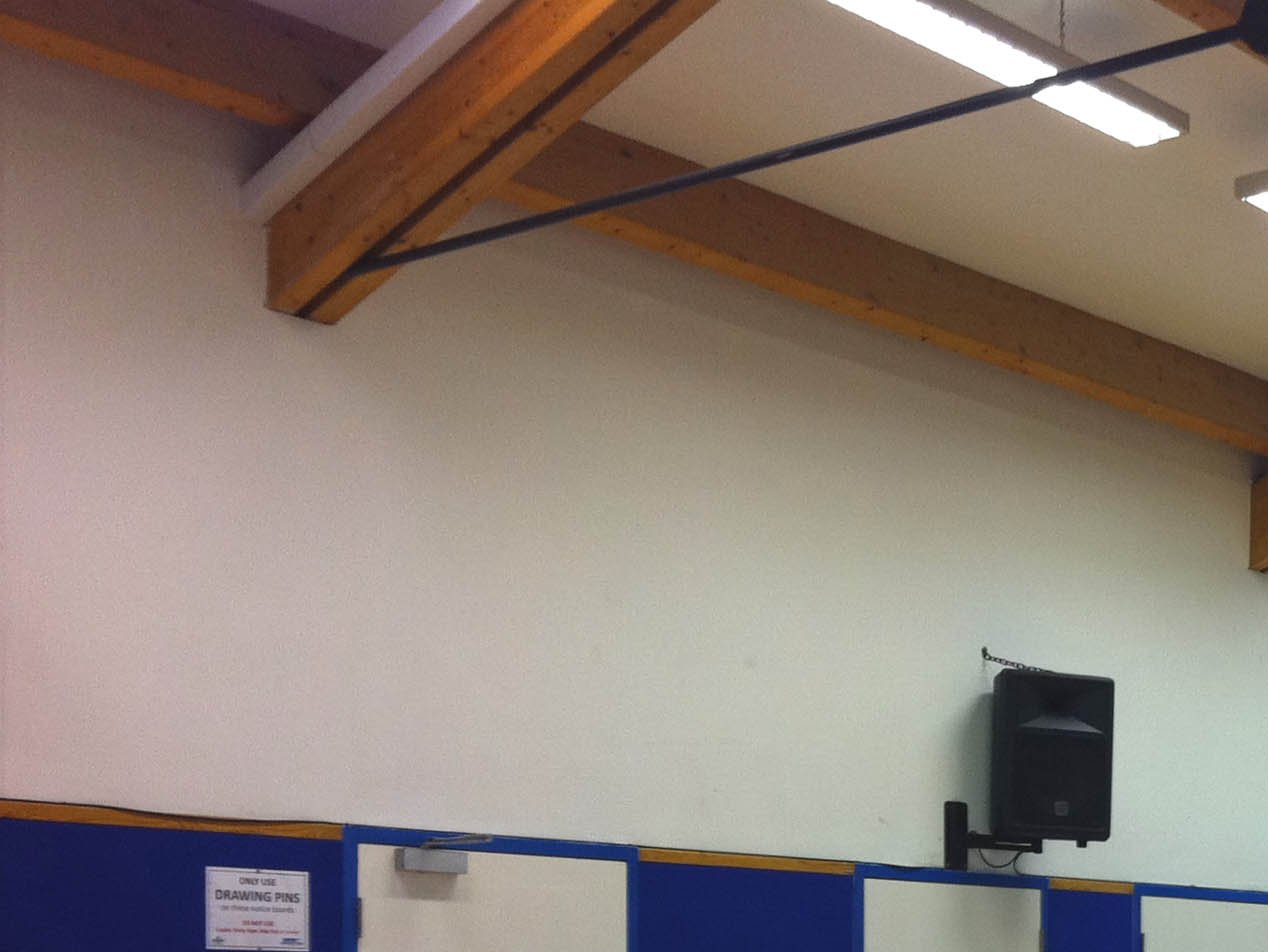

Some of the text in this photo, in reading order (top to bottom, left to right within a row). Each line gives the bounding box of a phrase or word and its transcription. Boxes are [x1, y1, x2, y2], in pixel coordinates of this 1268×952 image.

[239, 877, 276, 886] ONLY USE
[215, 889, 300, 903] DRAWING PINS
